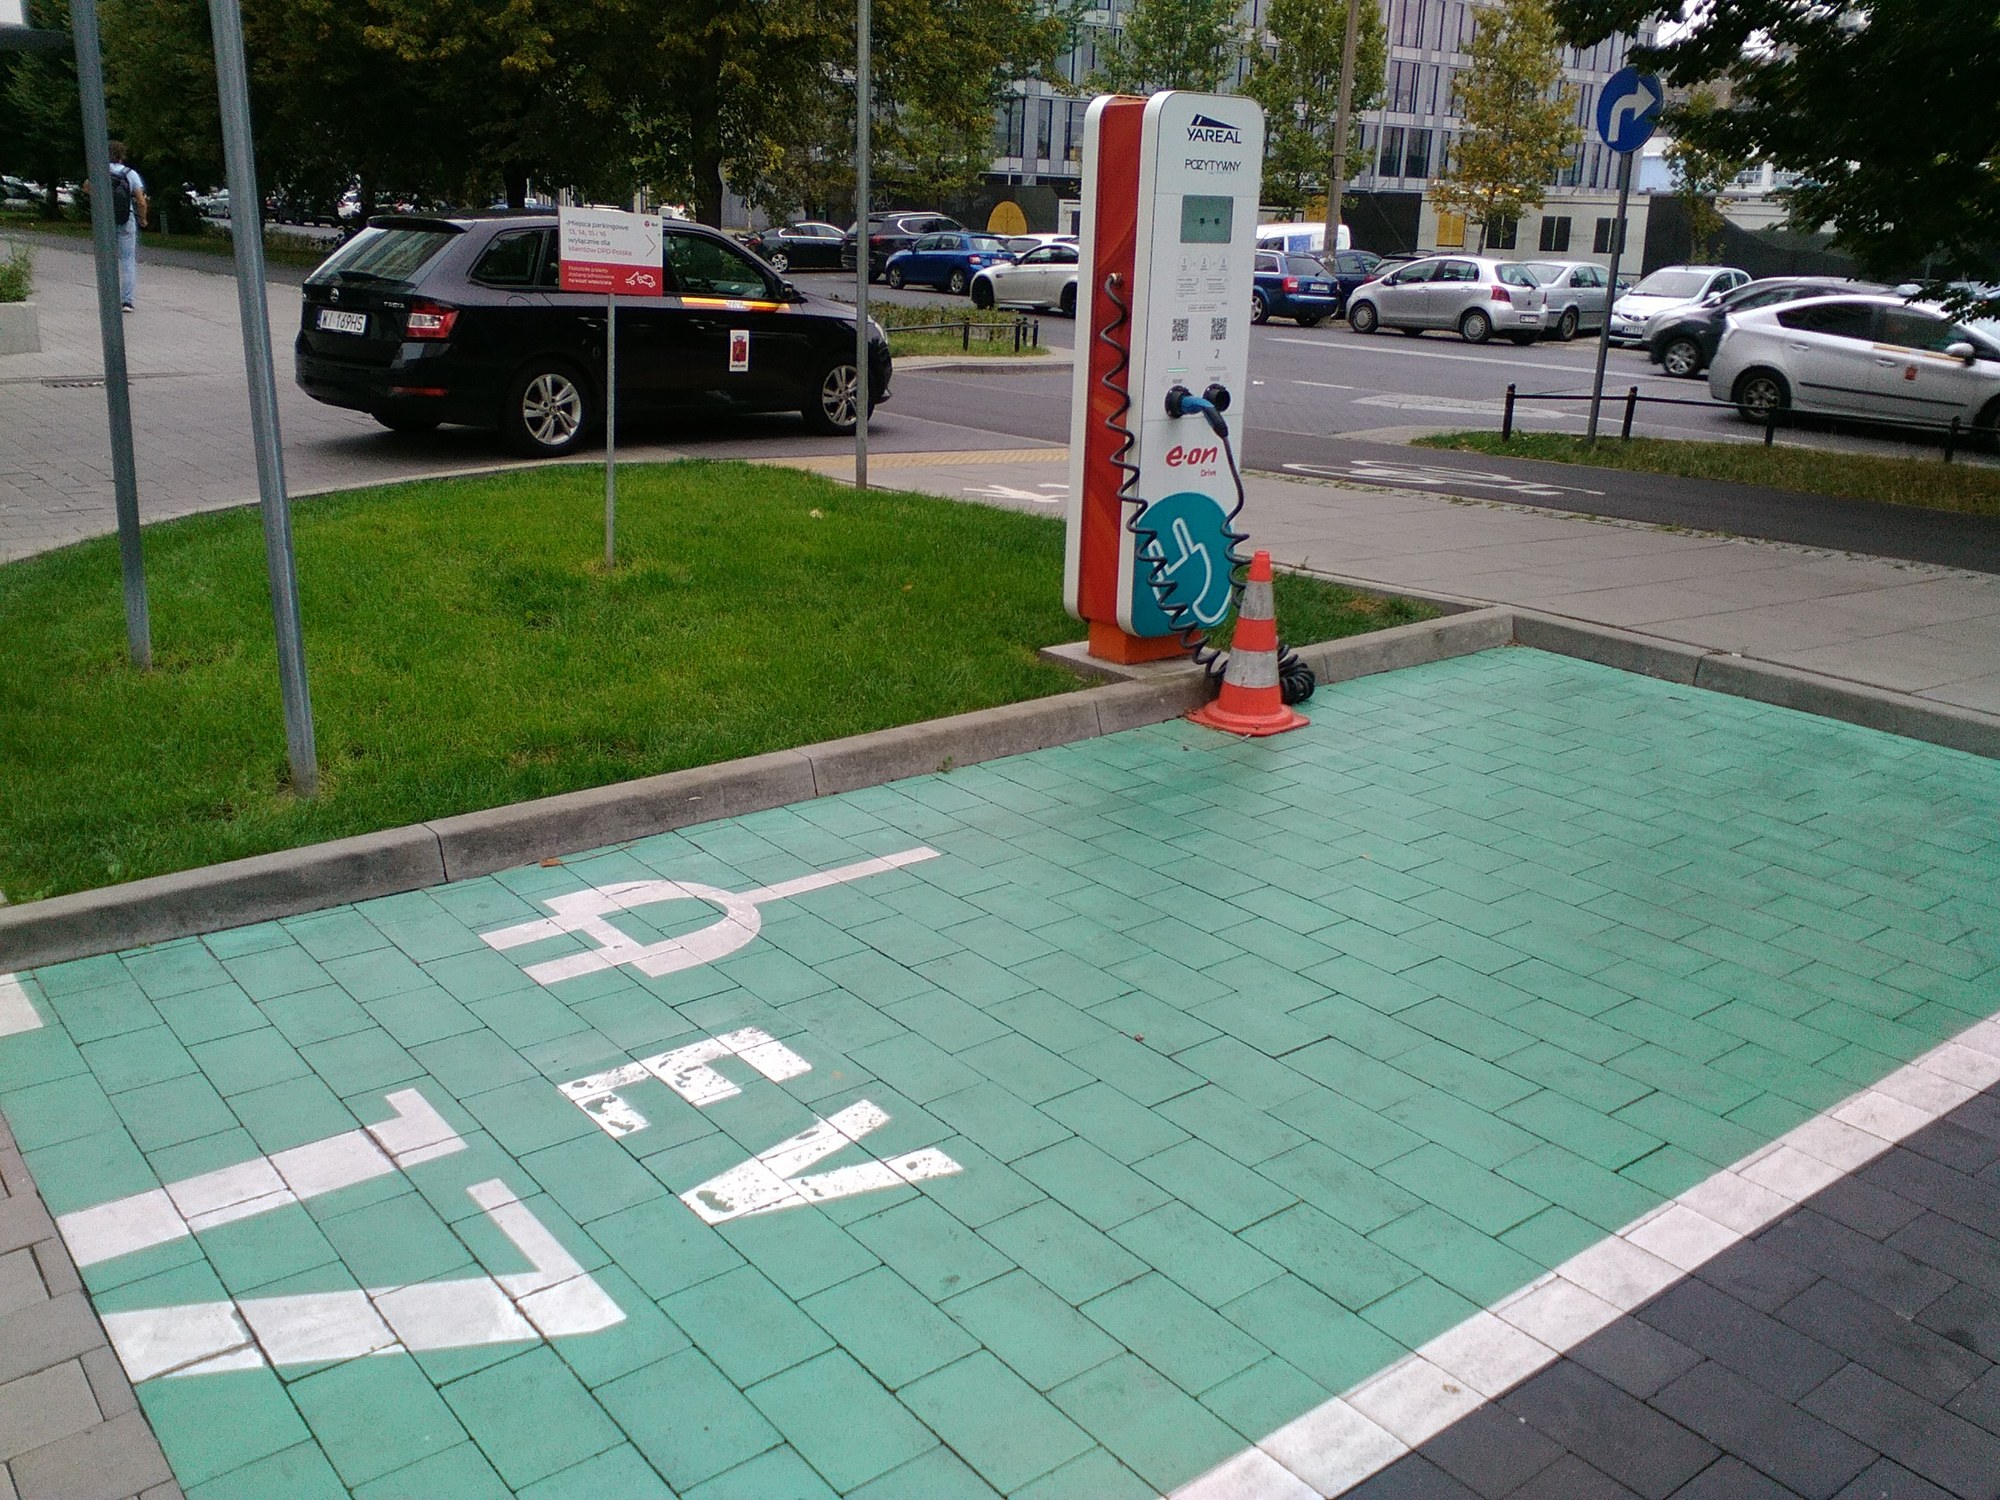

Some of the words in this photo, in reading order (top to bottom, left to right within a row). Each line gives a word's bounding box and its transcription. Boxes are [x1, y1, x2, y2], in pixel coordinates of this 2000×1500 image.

[1187, 128, 1242, 145] YAREAL
[1185, 159, 1242, 171] POZYTYWNY
[322, 312, 333, 327] WI
[337, 314, 363, 331] 169HS
[1200, 469, 1217, 477] Drive
[557, 1026, 964, 1226] EV
